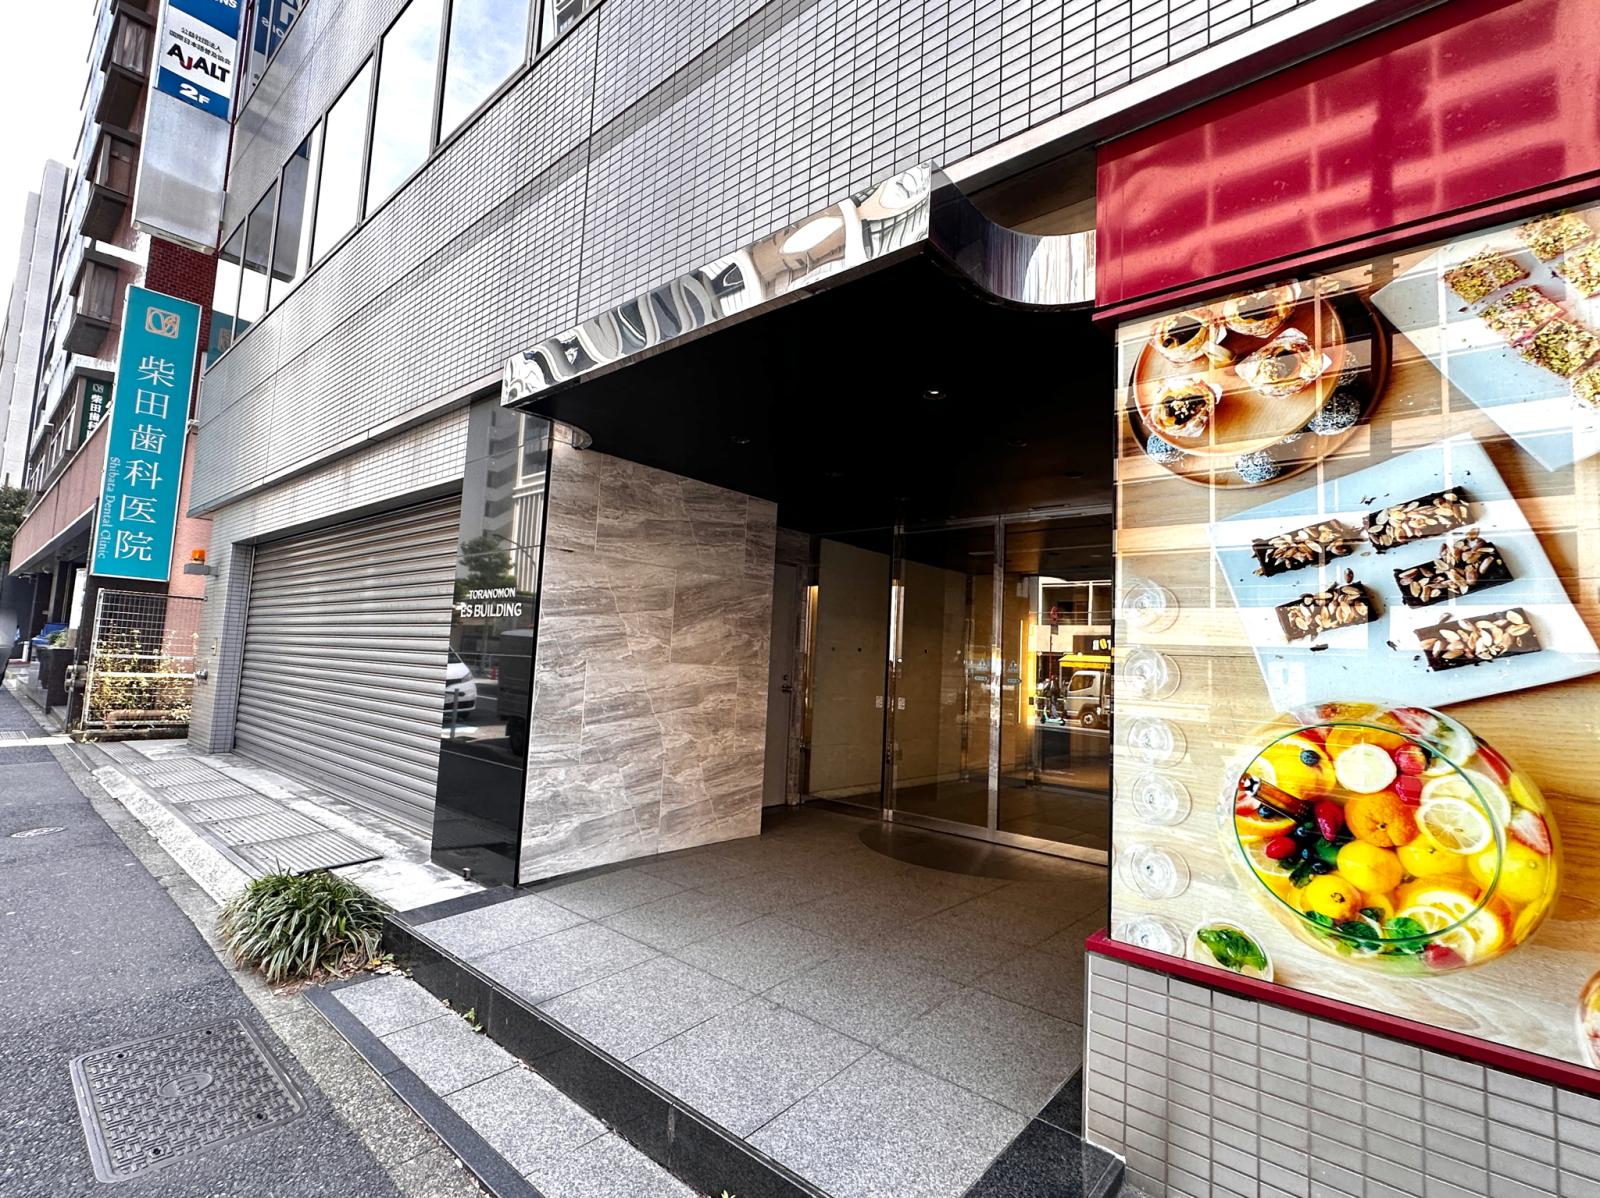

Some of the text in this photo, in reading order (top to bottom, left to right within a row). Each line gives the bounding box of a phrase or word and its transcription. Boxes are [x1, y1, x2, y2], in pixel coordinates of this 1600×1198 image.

[167, 43, 230, 82] AJALT
[179, 82, 210, 104] 2F
[114, 355, 175, 561] 柴田歯科医院
[97, 456, 120, 559] Shibata Dental Clinic
[468, 587, 516, 600] TORANOMON
[473, 602, 522, 617] BUILDING
